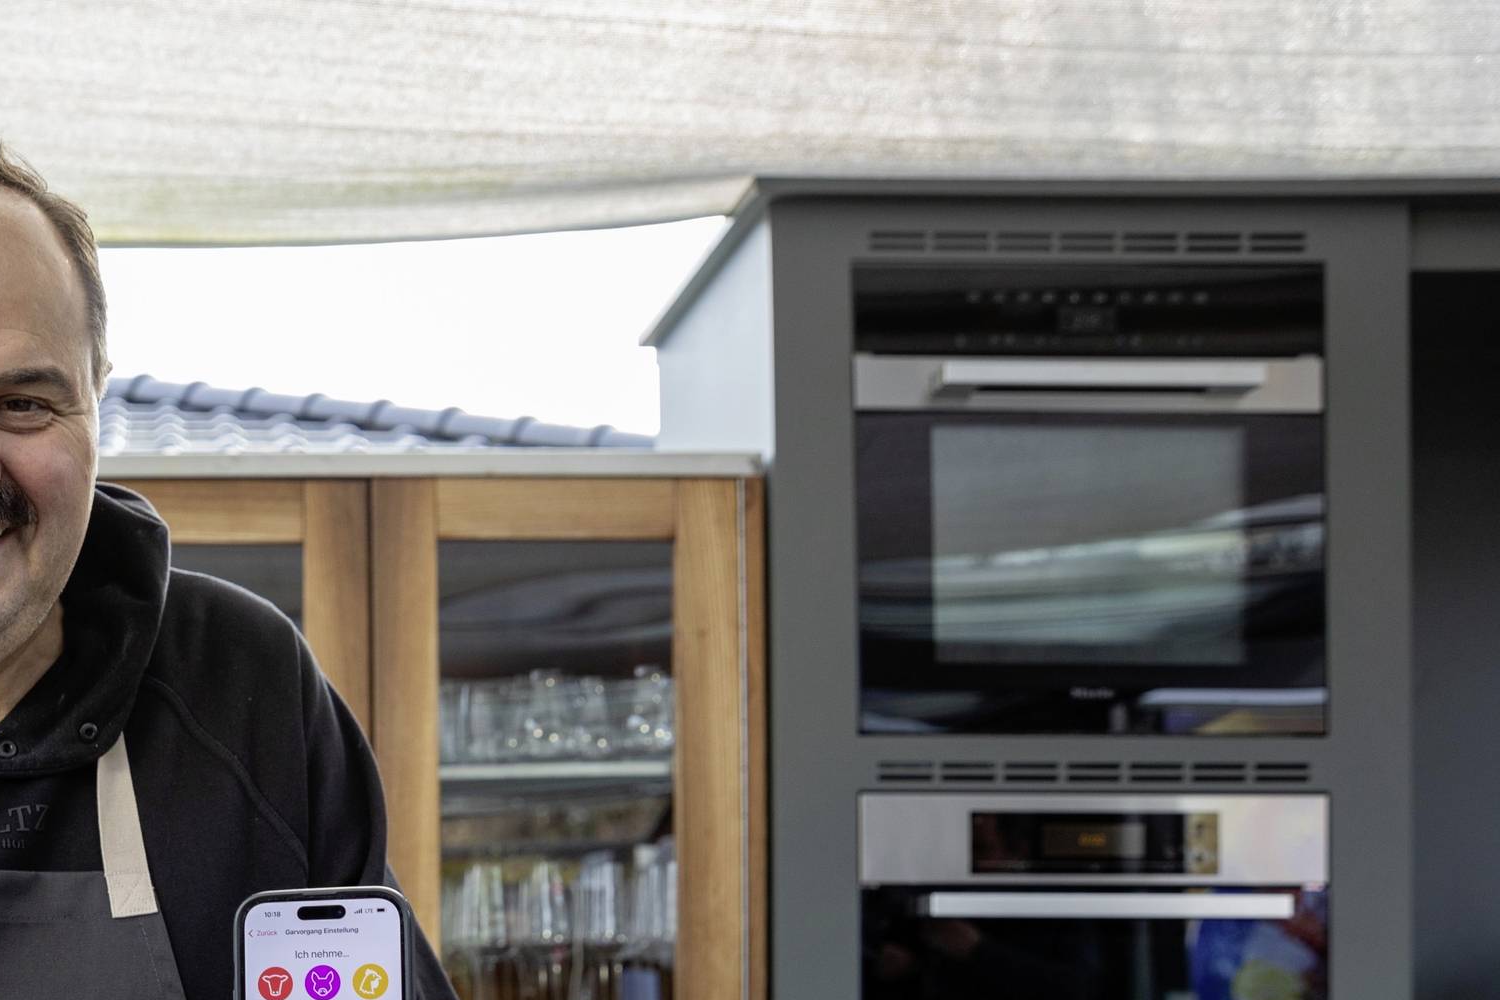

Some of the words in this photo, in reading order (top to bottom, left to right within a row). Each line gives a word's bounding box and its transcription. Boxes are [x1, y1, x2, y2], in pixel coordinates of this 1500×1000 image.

[256, 929, 278, 937] Zurück
[285, 928, 322, 936] Garvorgang
[323, 926, 359, 935] Einstellung
[294, 949, 309, 959] Ich
